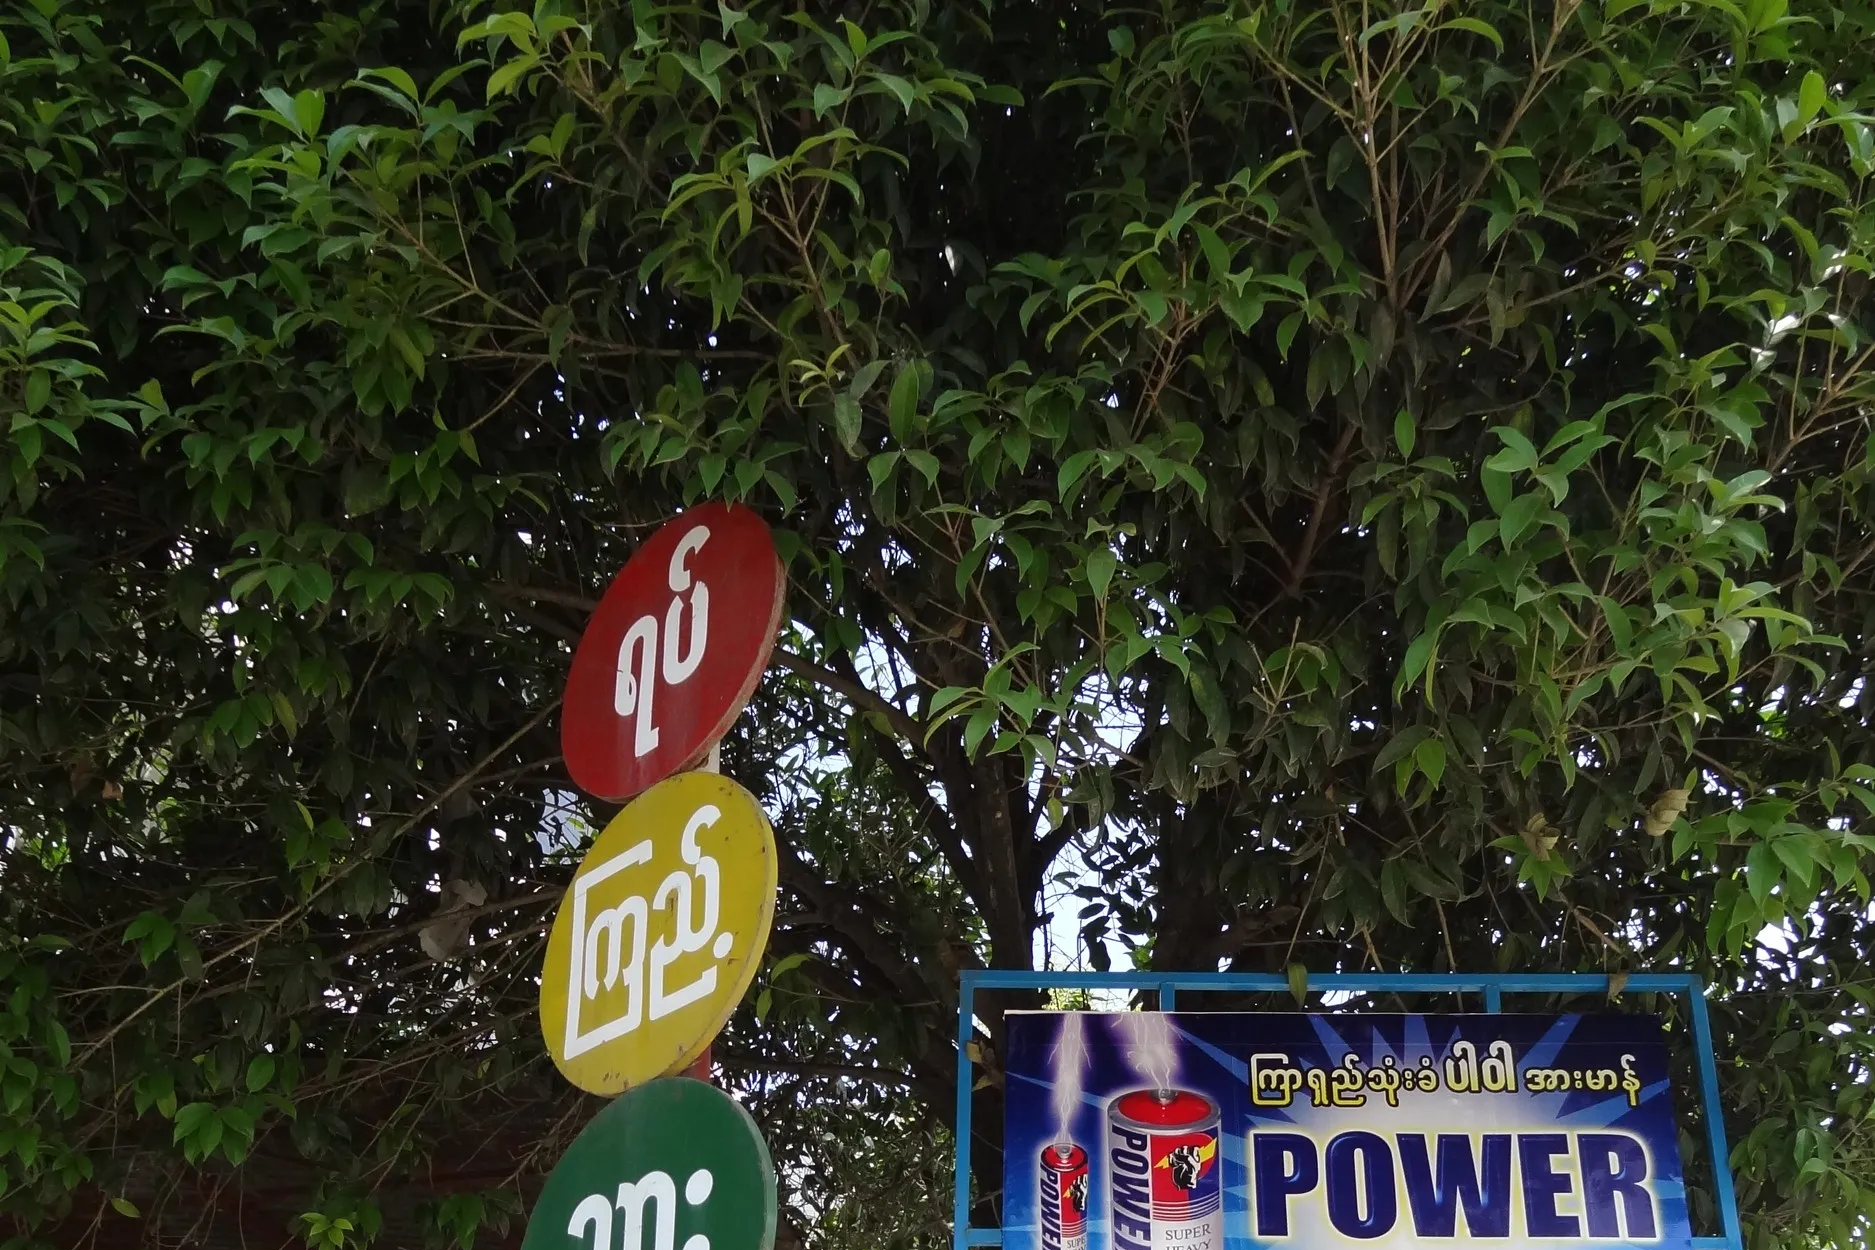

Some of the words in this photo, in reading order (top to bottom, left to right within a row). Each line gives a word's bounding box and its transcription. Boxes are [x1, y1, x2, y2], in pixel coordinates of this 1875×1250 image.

[613, 524, 711, 758] ရပ်
[1164, 1223, 1212, 1241] SUPER
[1252, 1130, 1658, 1240] POWER
